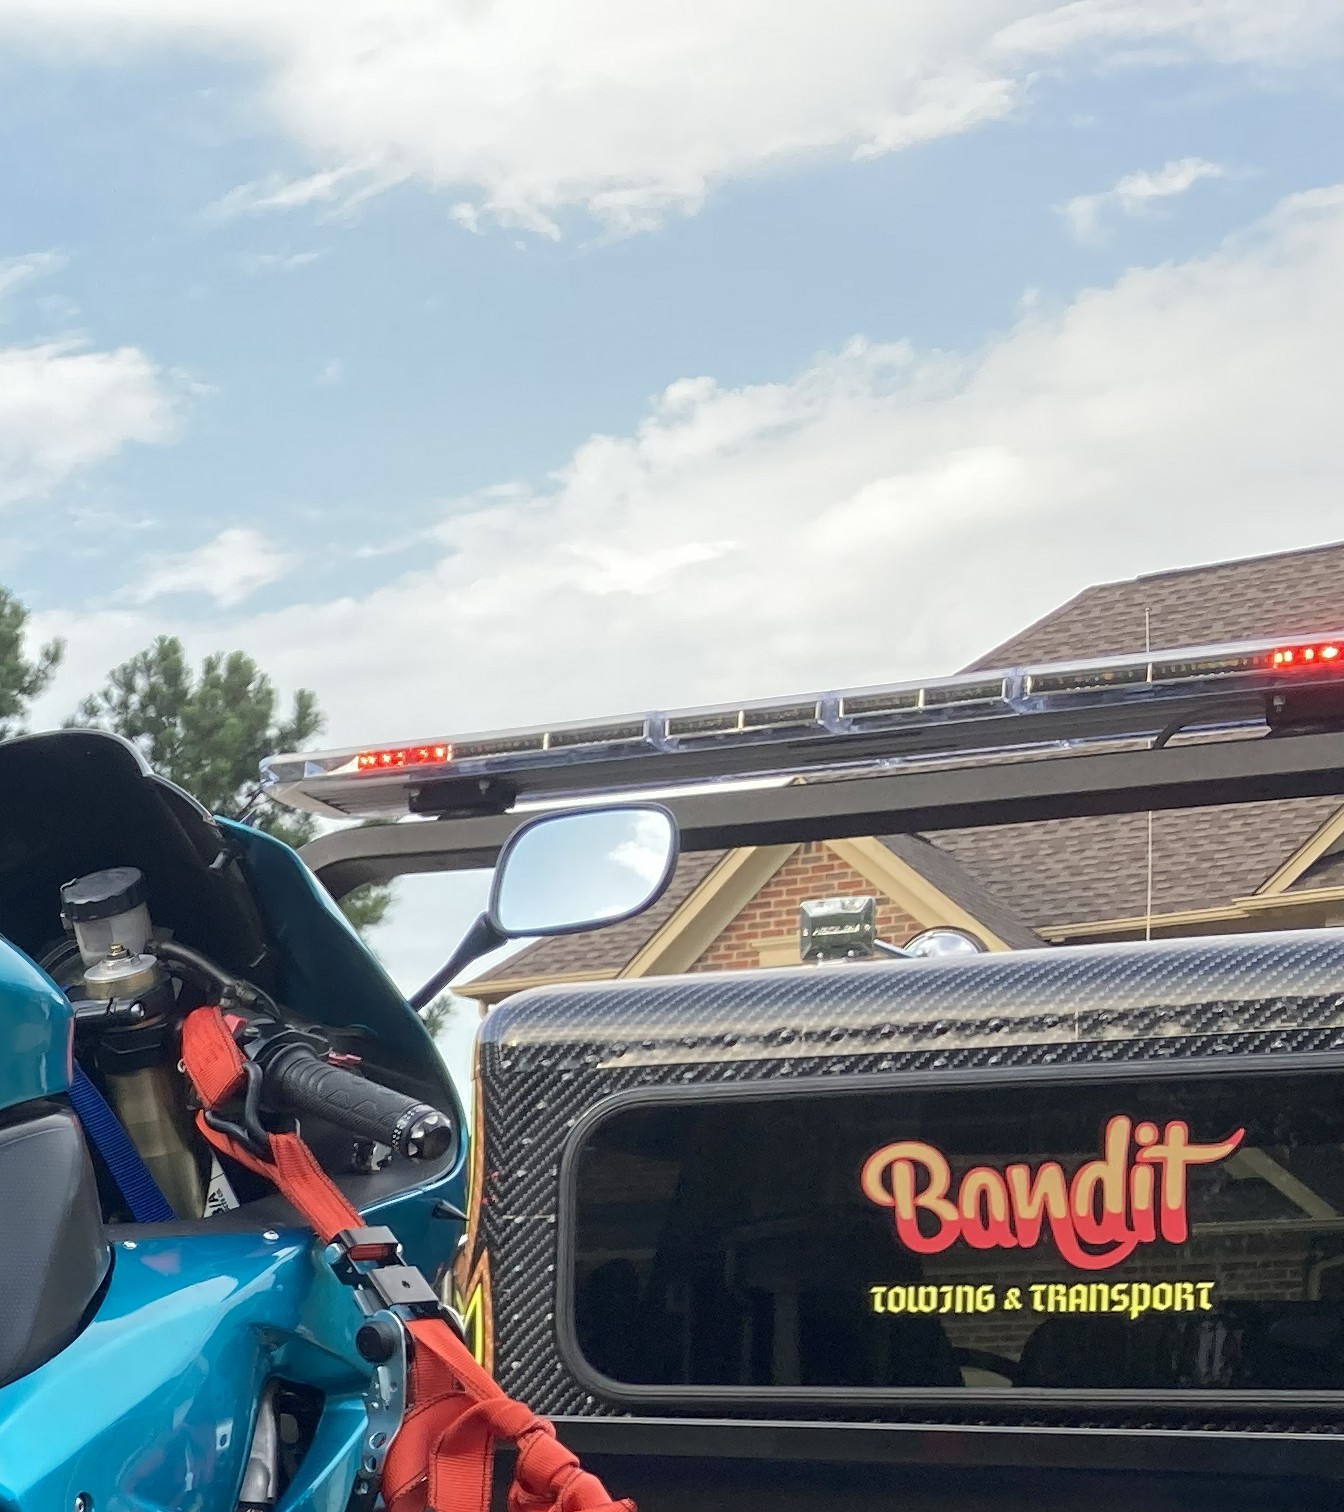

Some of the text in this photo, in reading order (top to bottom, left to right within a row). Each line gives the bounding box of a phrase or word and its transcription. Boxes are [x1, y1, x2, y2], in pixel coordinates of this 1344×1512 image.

[861, 1115, 1246, 1270] Bandit
[869, 1281, 1216, 1320] TOWING & TRANSPORT
